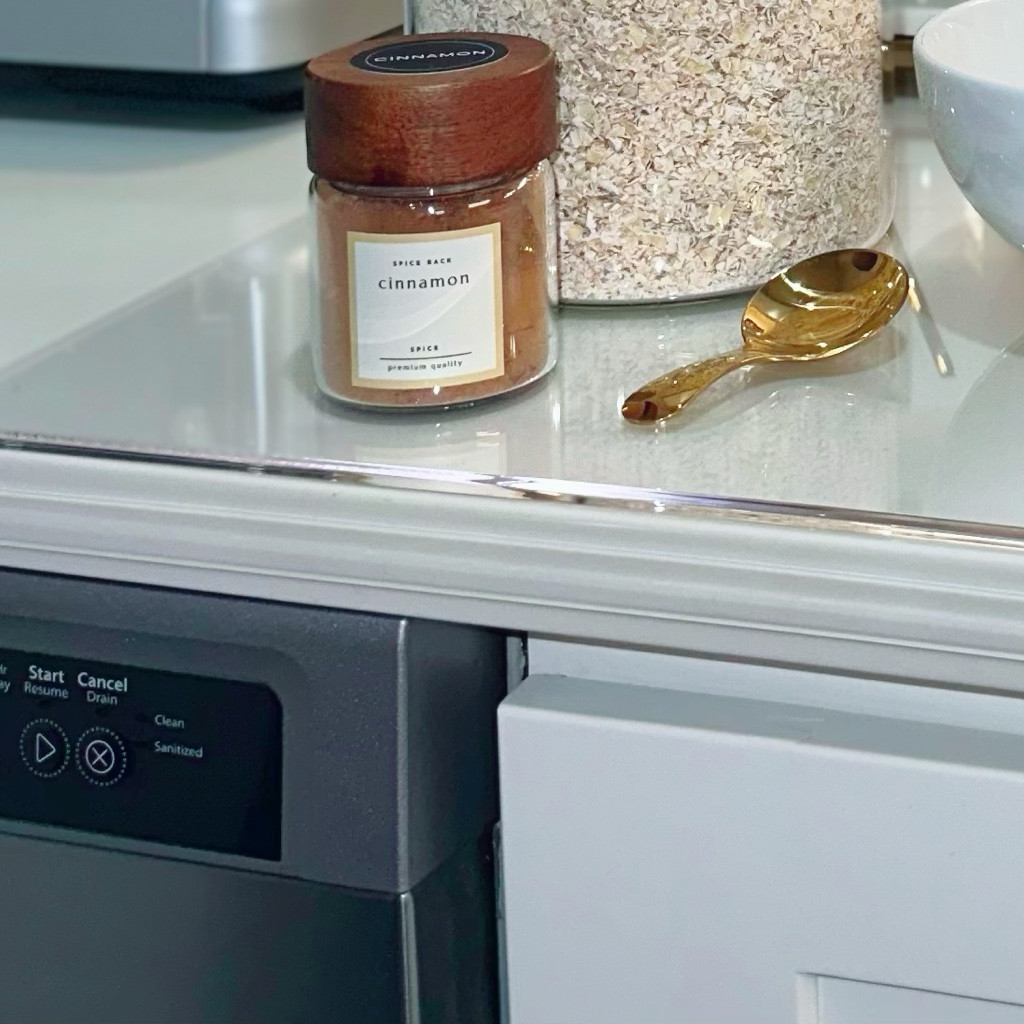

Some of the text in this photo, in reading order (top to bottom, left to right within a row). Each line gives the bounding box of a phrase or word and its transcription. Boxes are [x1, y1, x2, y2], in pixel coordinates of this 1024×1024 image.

[374, 48, 486, 62] CINNAMON
[378, 273, 470, 290] cinnamon
[410, 344, 439, 353] SPICE
[387, 360, 463, 372] premium quality
[29, 665, 65, 684] Start
[77, 671, 128, 692] Cancel
[24, 680, 69, 699] Resume
[86, 691, 118, 706] Drain
[154, 714, 185, 729] Clean
[154, 740, 204, 758] Sanitized
